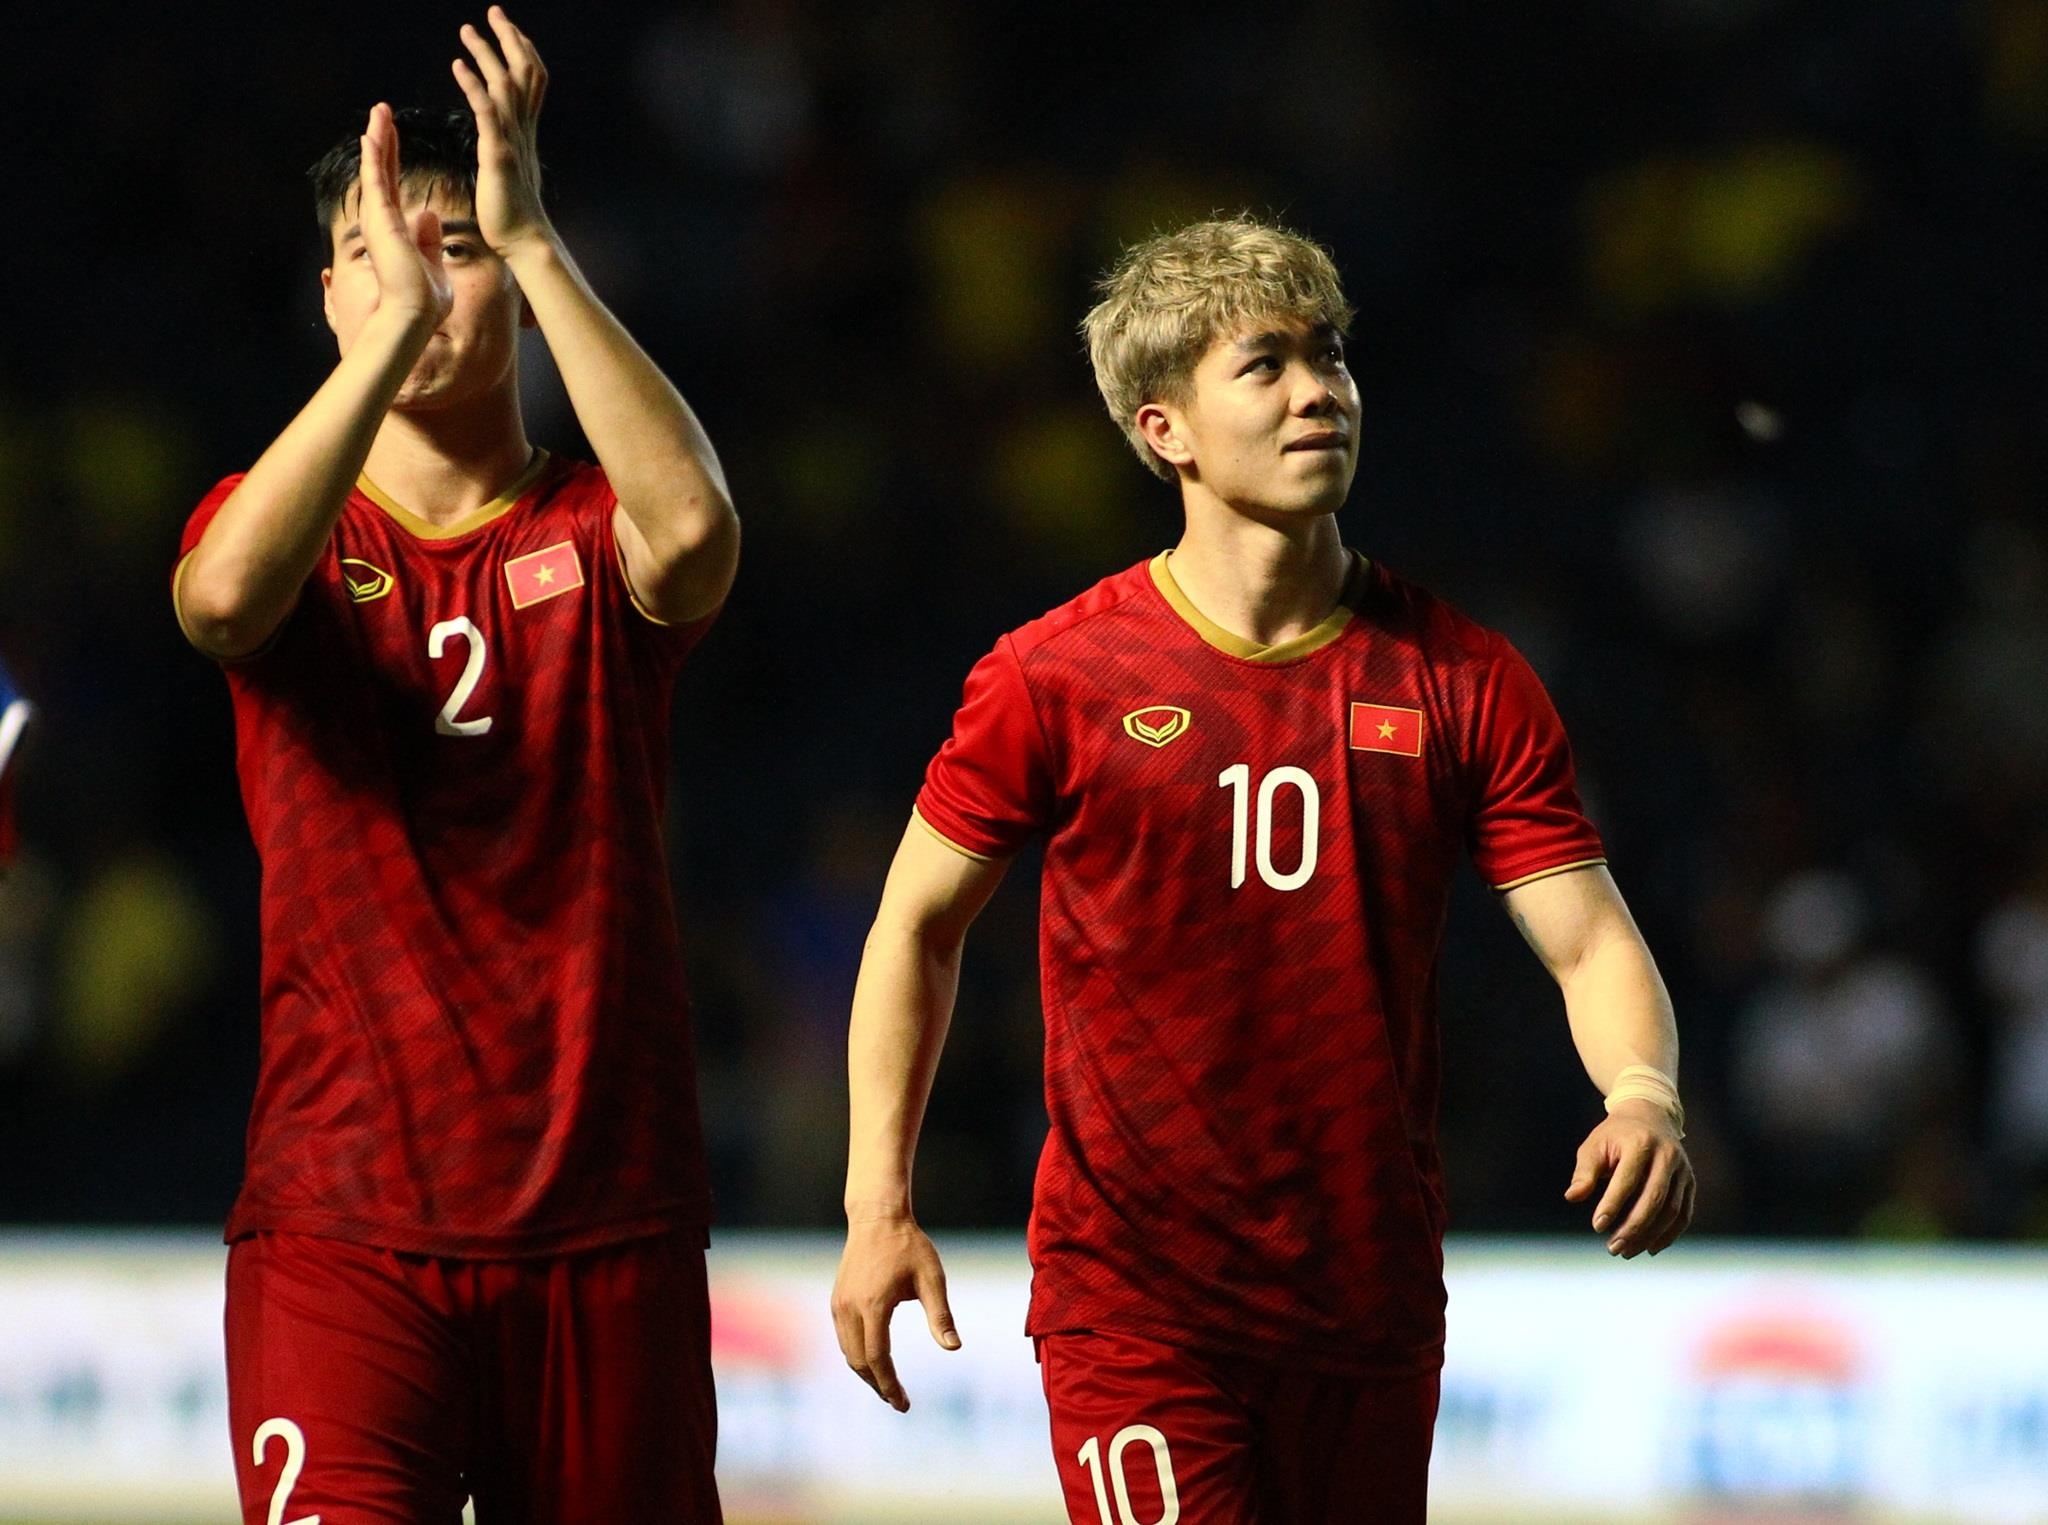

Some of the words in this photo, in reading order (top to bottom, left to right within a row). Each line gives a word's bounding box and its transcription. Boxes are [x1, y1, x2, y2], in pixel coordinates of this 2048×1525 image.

[428, 615, 493, 736] 2
[1218, 763, 1320, 891] 10
[252, 1417, 321, 1525] 2
[1077, 1424, 1180, 1525] 10
